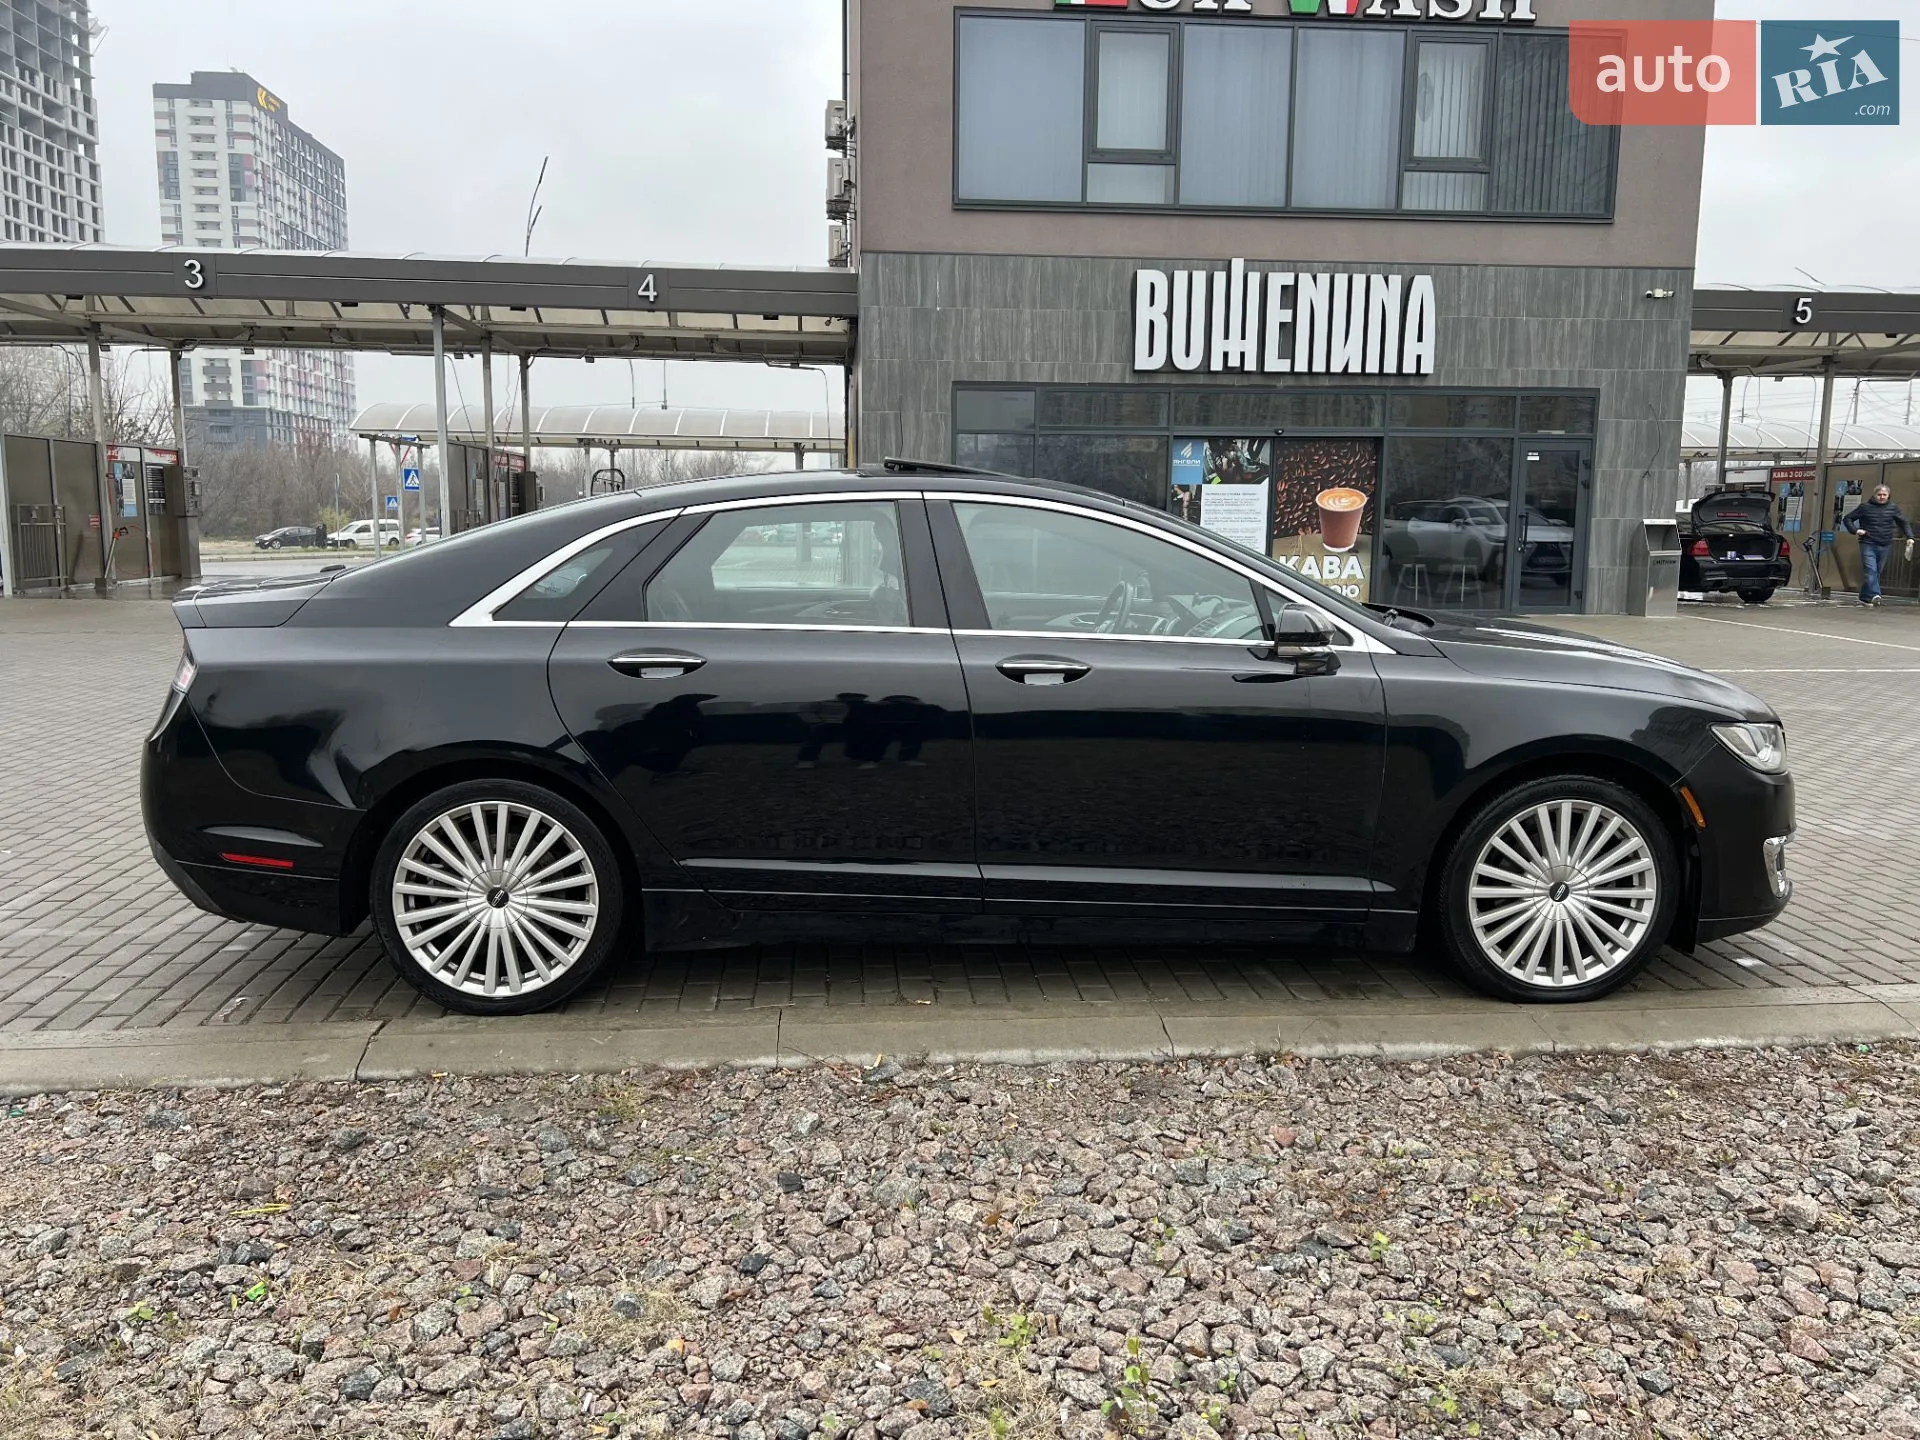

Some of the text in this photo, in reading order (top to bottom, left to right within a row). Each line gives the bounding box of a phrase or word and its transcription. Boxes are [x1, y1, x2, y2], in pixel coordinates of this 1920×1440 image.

[184, 259, 204, 289] 3
[637, 273, 658, 302] 4
[1795, 297, 1812, 324] 5
[1279, 555, 1365, 579] КАВА
